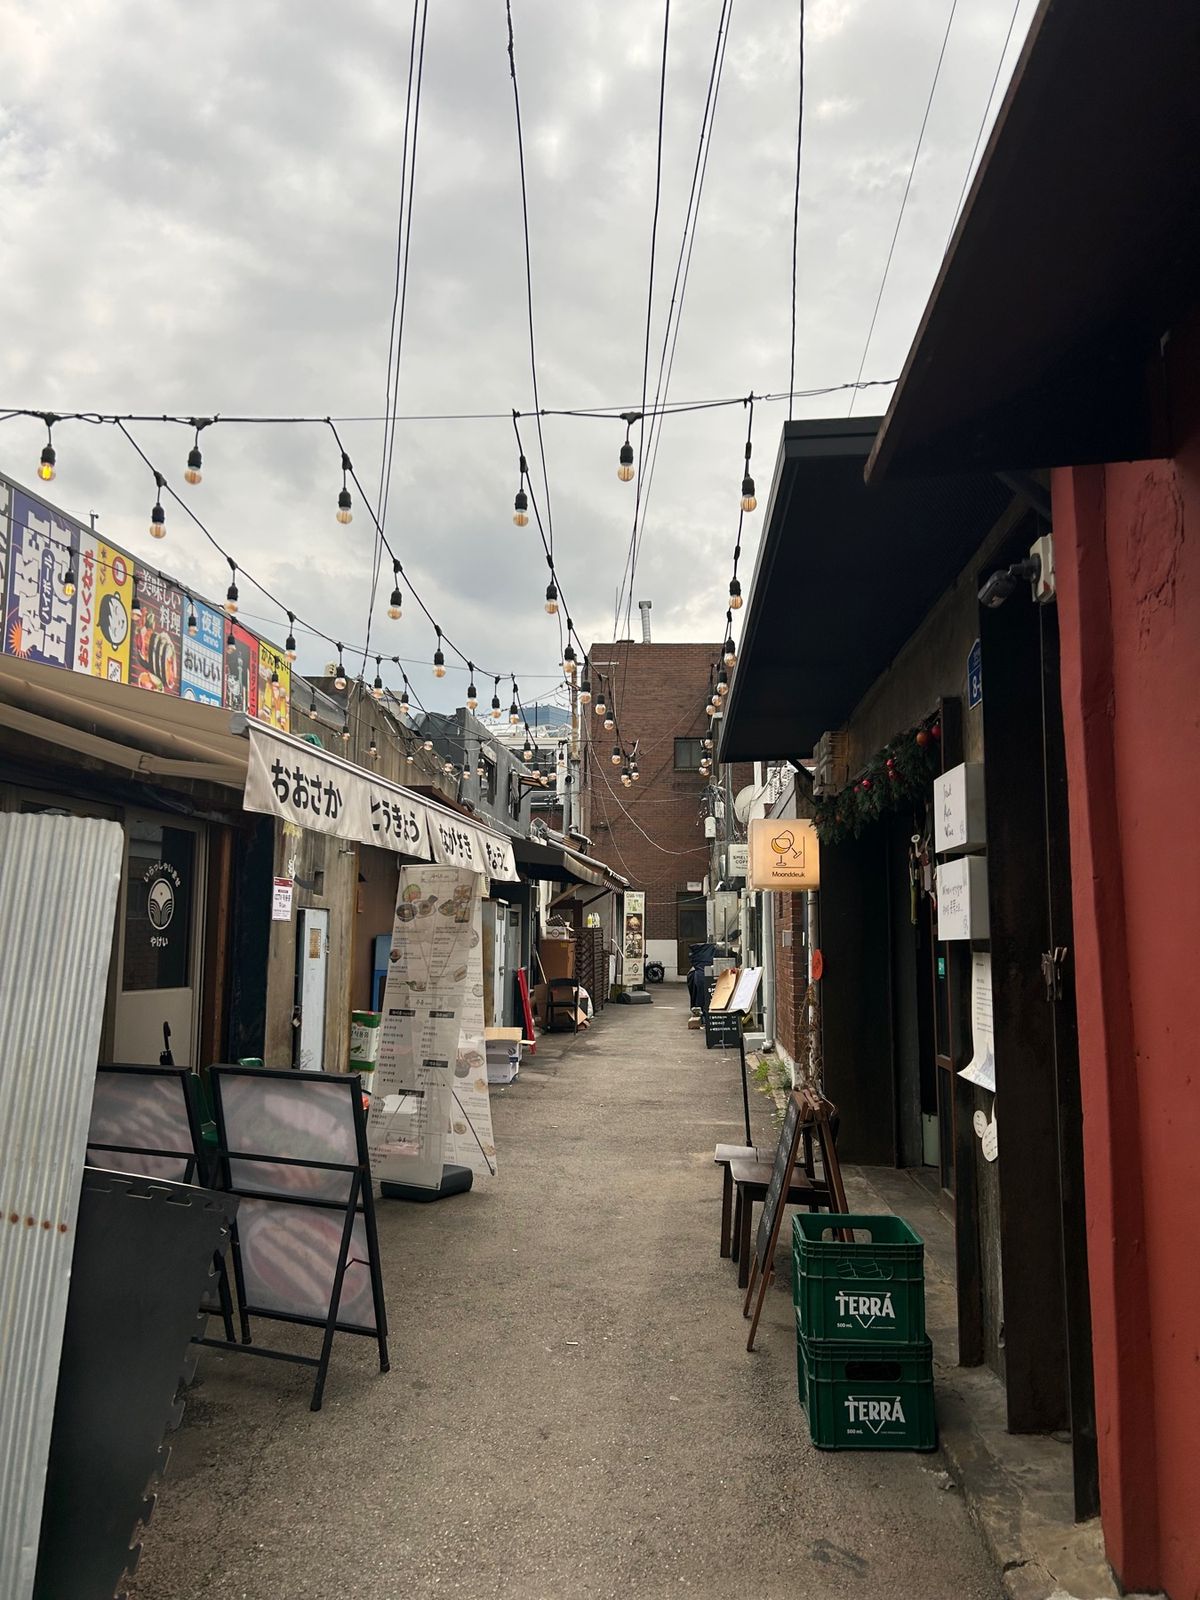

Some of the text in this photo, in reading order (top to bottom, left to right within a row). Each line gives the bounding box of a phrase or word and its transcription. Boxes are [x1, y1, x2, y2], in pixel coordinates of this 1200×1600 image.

[41, 555, 53, 619] ハイボール
[44, 520, 72, 663] HIGH
[138, 570, 181, 608] 美味しい
[78, 549, 94, 667] おいしくなれ
[160, 606, 181, 636] 料理
[202, 610, 222, 640] 夜景
[184, 648, 221, 681] おいしい
[271, 758, 343, 819] おおさか
[370, 795, 420, 843] とうきょう
[438, 824, 473, 860] ながさき
[150, 936, 169, 947] やけい
